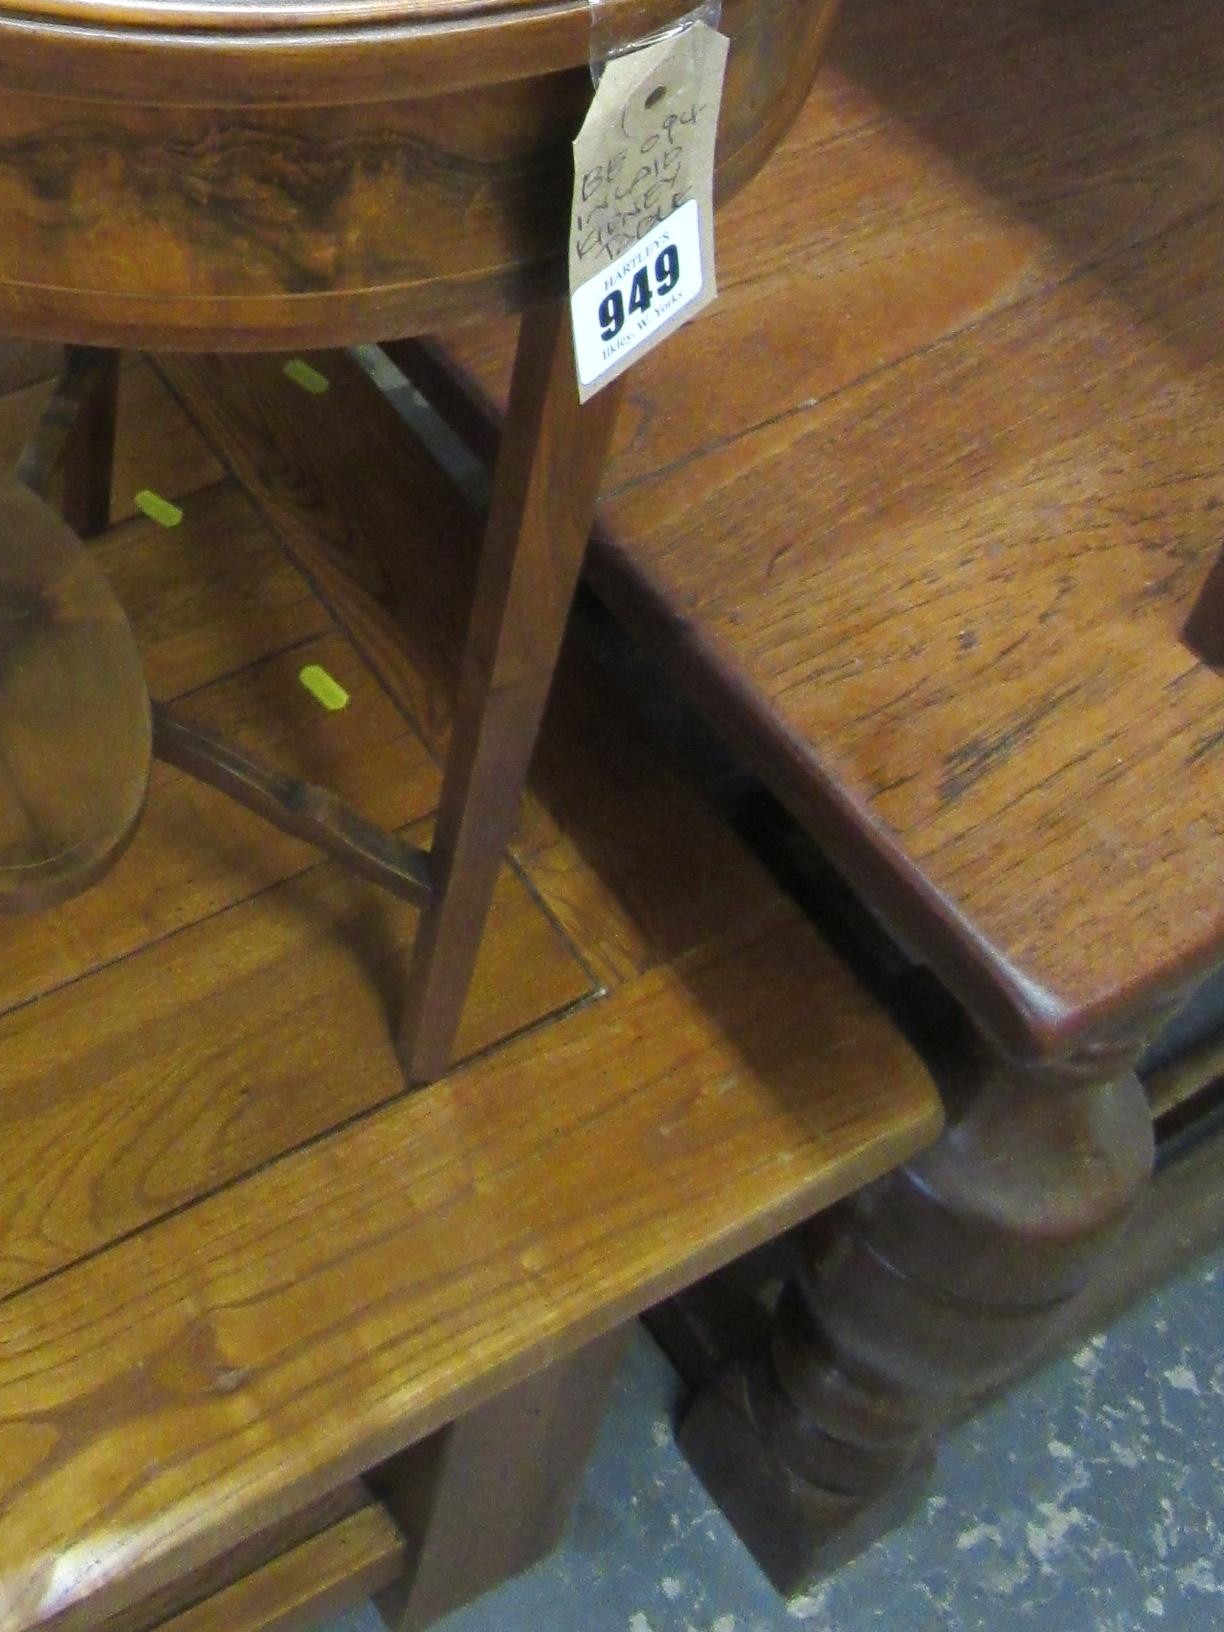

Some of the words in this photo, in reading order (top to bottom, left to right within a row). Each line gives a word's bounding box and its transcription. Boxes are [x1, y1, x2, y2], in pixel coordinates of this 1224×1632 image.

[576, 161, 681, 259] KIDNEY
[577, 146, 682, 231] INLAID
[598, 244, 680, 341] 949
[603, 230, 670, 291] HARTLEYS
[655, 291, 683, 316] Yorks
